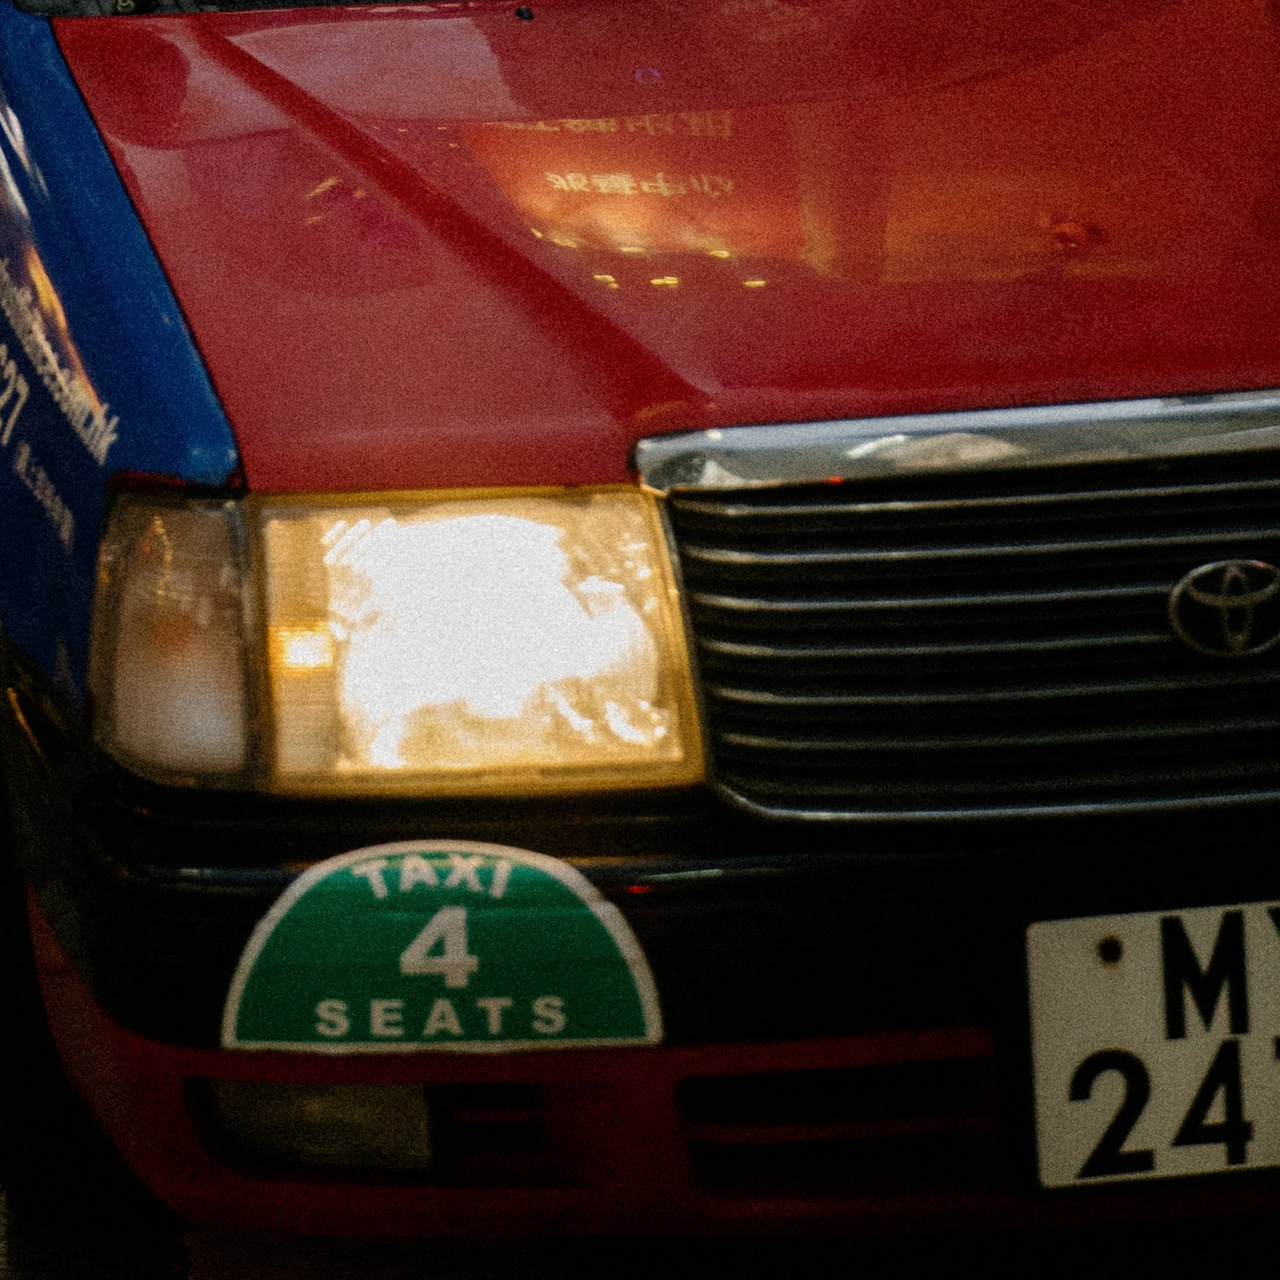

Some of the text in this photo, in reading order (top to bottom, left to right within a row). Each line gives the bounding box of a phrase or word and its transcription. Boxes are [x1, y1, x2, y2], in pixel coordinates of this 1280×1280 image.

[352, 853, 512, 899] TAXI
[399, 905, 479, 990] 4
[1160, 906, 1280, 1040] M
[313, 995, 570, 1039] SEATS
[1069, 1035, 1280, 1180] 24
